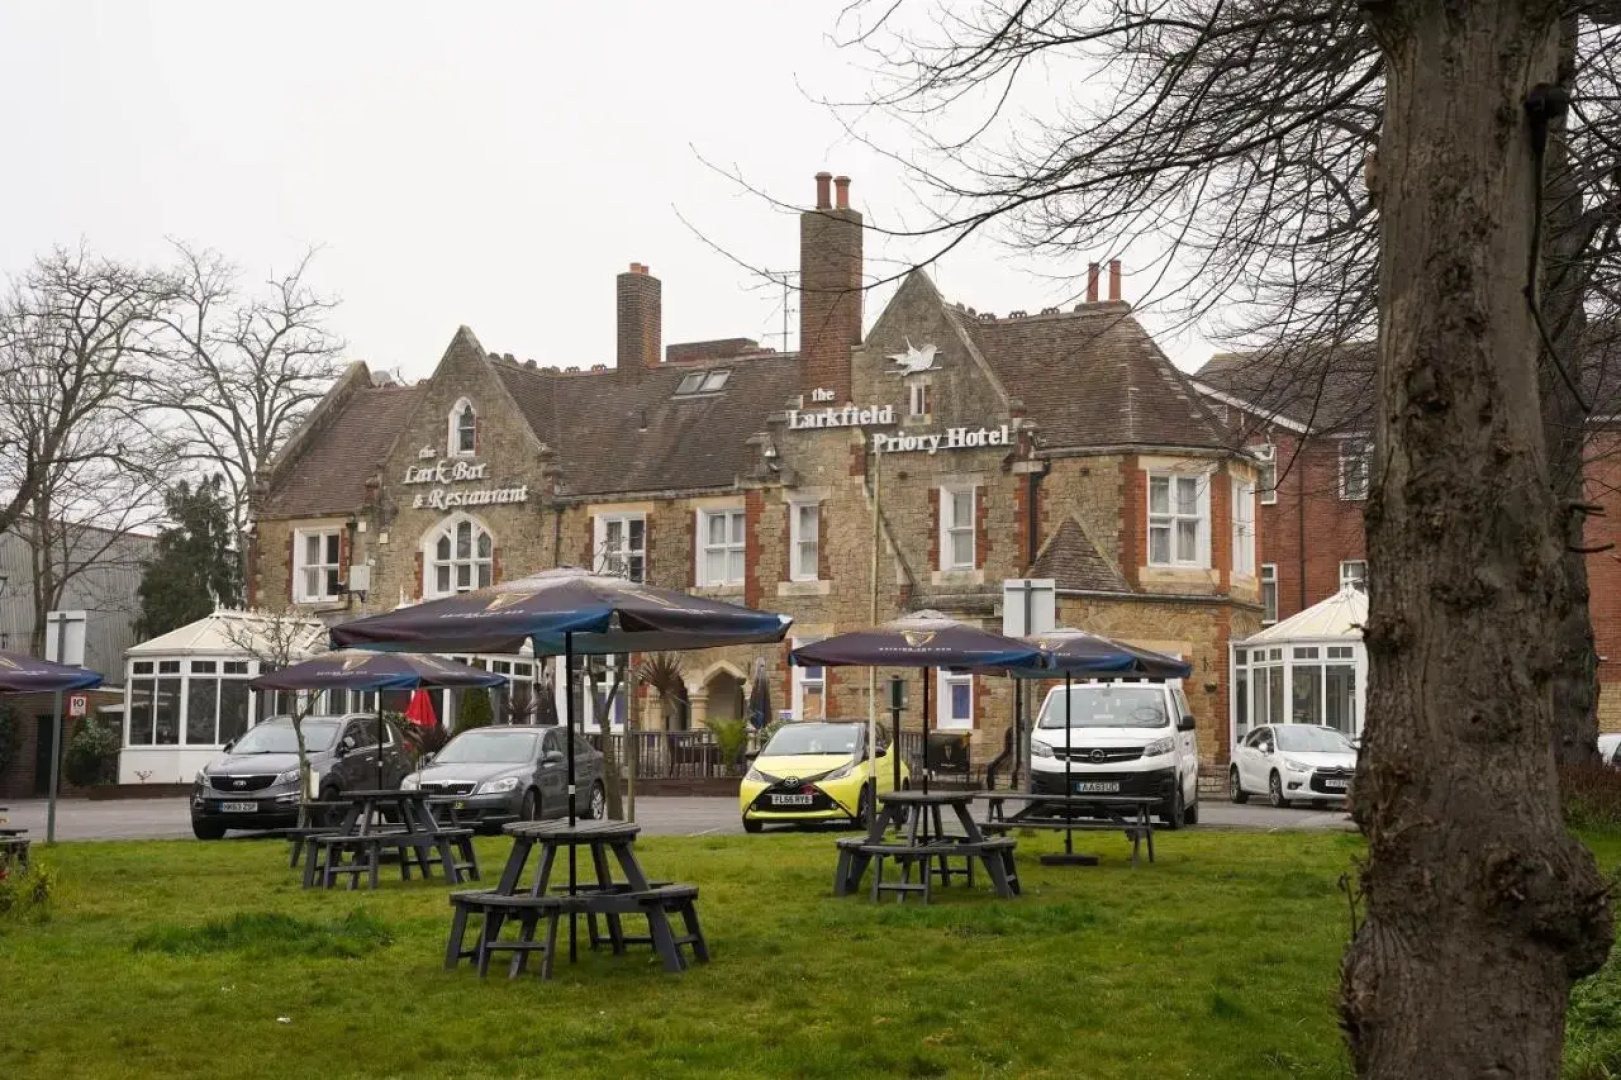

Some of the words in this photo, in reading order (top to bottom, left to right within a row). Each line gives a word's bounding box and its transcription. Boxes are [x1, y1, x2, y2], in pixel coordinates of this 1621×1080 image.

[812, 387, 835, 401] the
[788, 404, 894, 429] Larkfield
[872, 432, 942, 455] Priory
[947, 425, 1010, 448] Hotel
[403, 460, 451, 484] Lark
[452, 461, 486, 481] Bar
[413, 494, 424, 508] &
[429, 485, 529, 510] Restaurant
